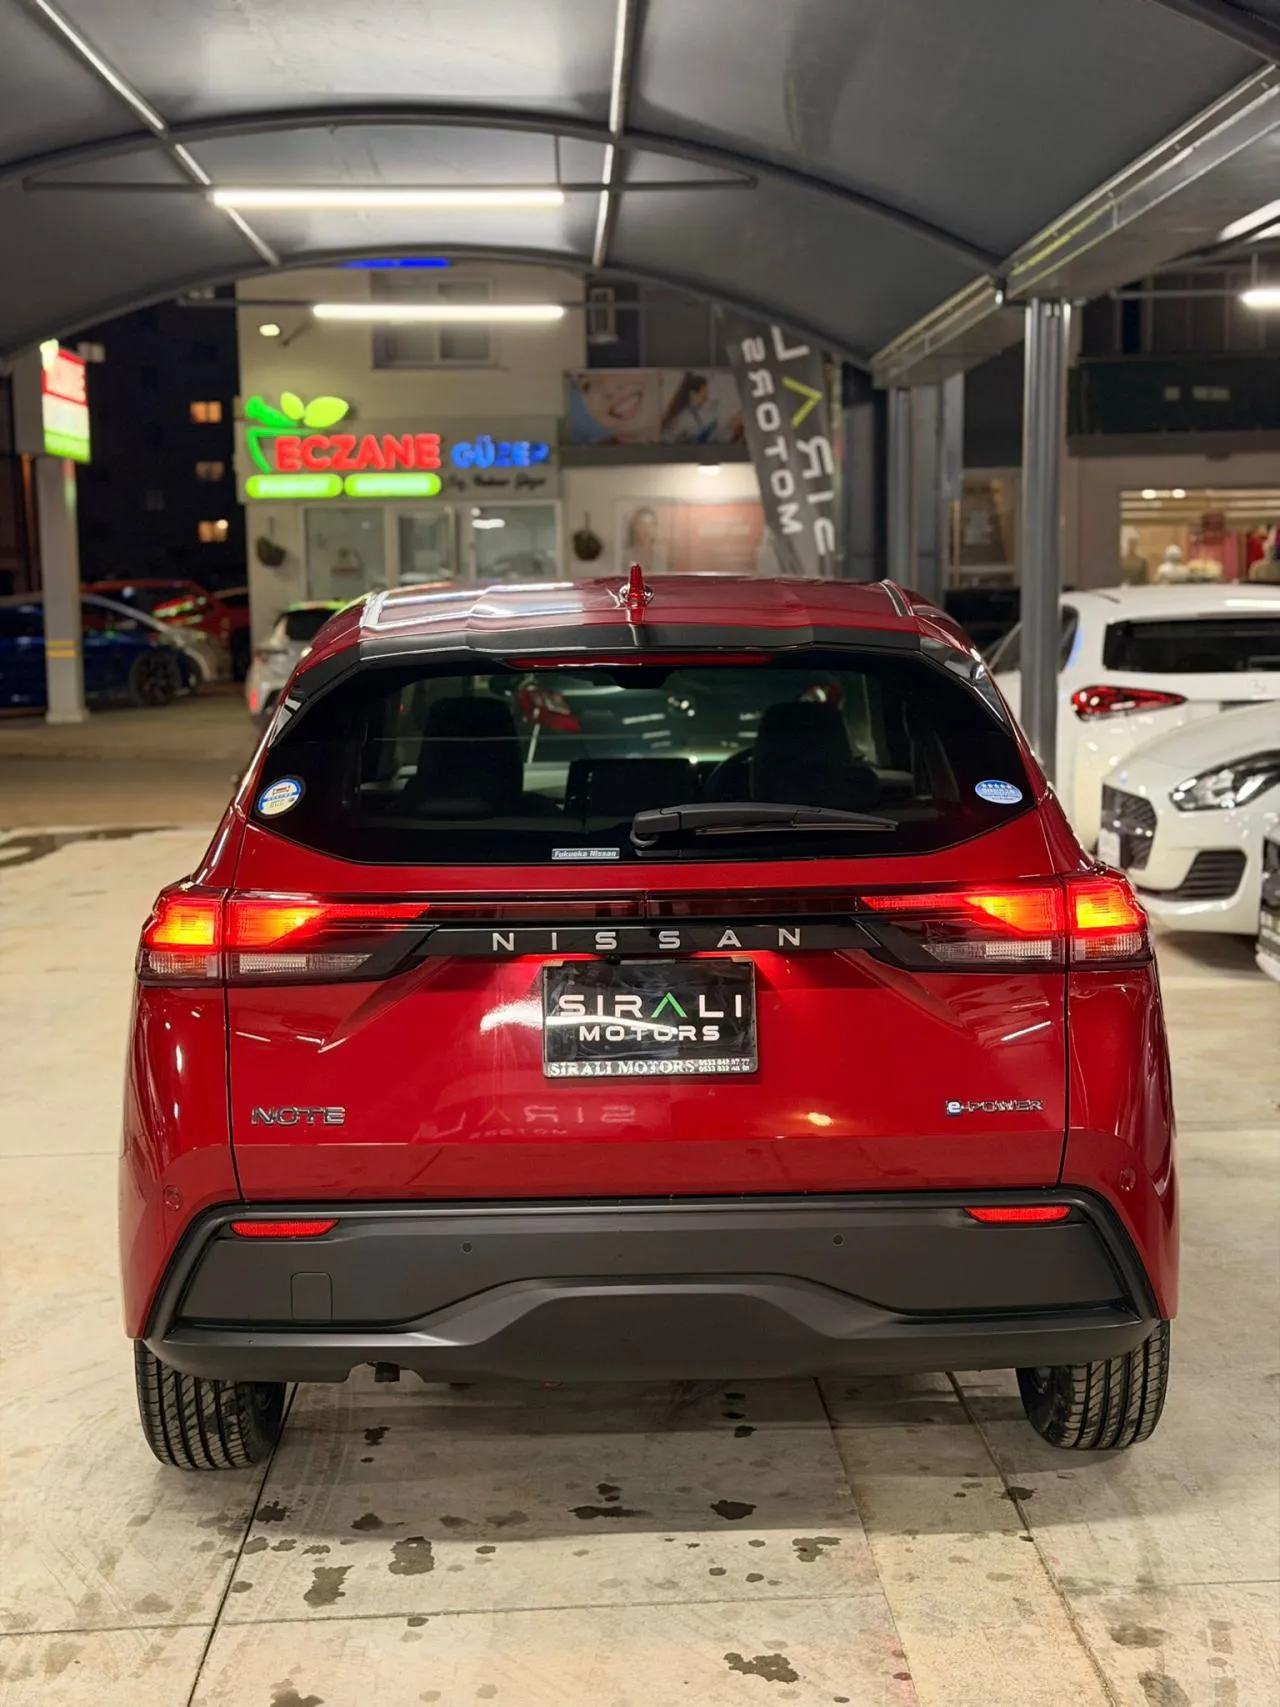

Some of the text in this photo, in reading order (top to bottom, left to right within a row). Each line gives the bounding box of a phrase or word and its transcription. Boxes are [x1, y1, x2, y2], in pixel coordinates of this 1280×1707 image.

[274, 433, 442, 472] ECZANE
[492, 928, 801, 951] NISSAN
[558, 991, 743, 1019] SIRALI
[579, 1024, 720, 1042] MOTORS
[550, 1058, 695, 1076] SIRALI MOTORS
[251, 1106, 346, 1125] NOTE
[946, 1100, 1043, 1116] e-POWER
